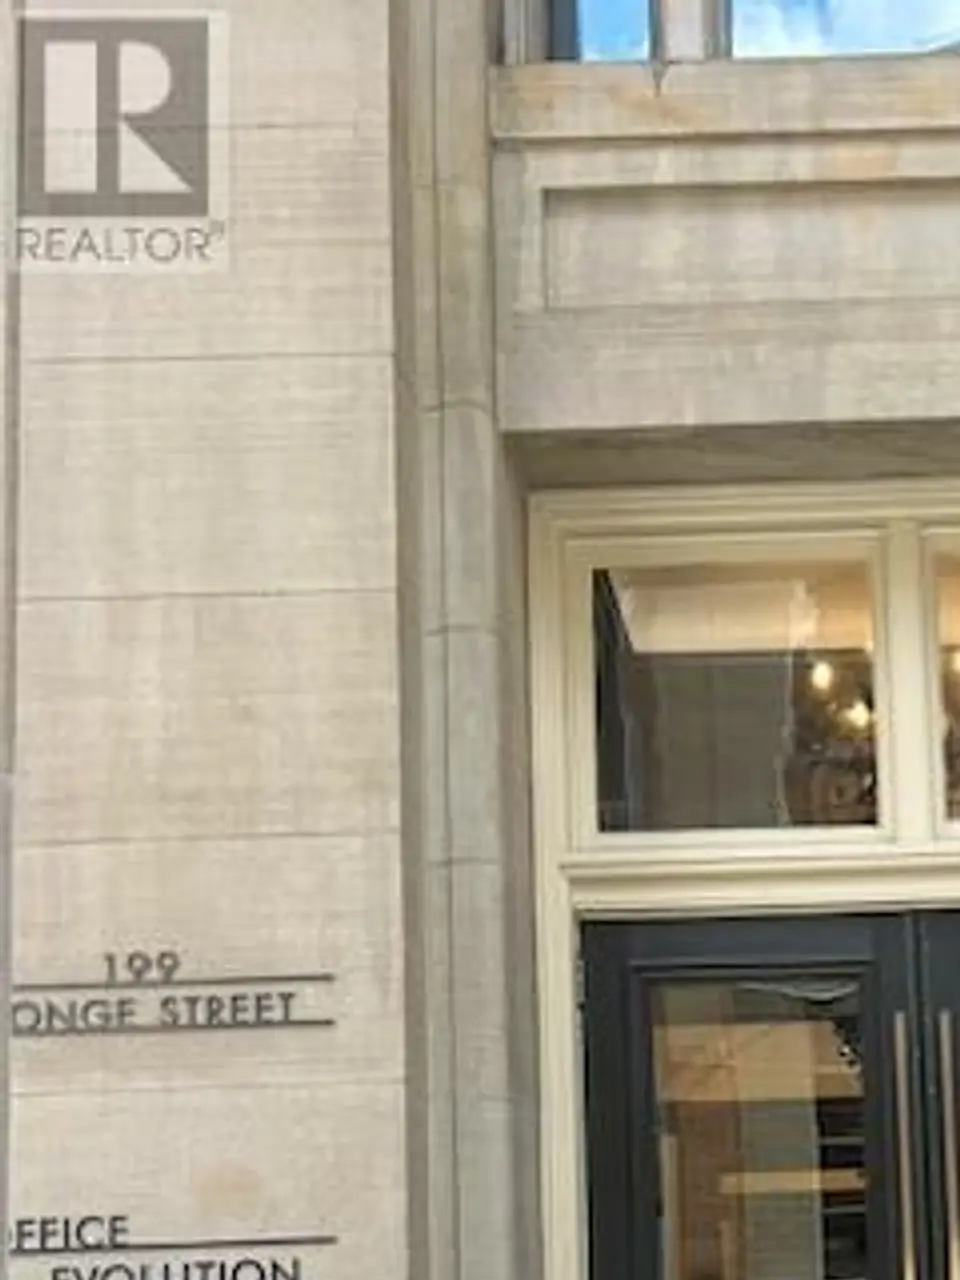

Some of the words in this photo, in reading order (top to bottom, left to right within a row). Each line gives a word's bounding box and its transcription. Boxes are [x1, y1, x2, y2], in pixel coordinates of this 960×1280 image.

[102, 951, 182, 988] 199
[10, 998, 138, 1034] ONGE
[159, 992, 296, 1027] STREET
[9, 1215, 129, 1251] FFICE
